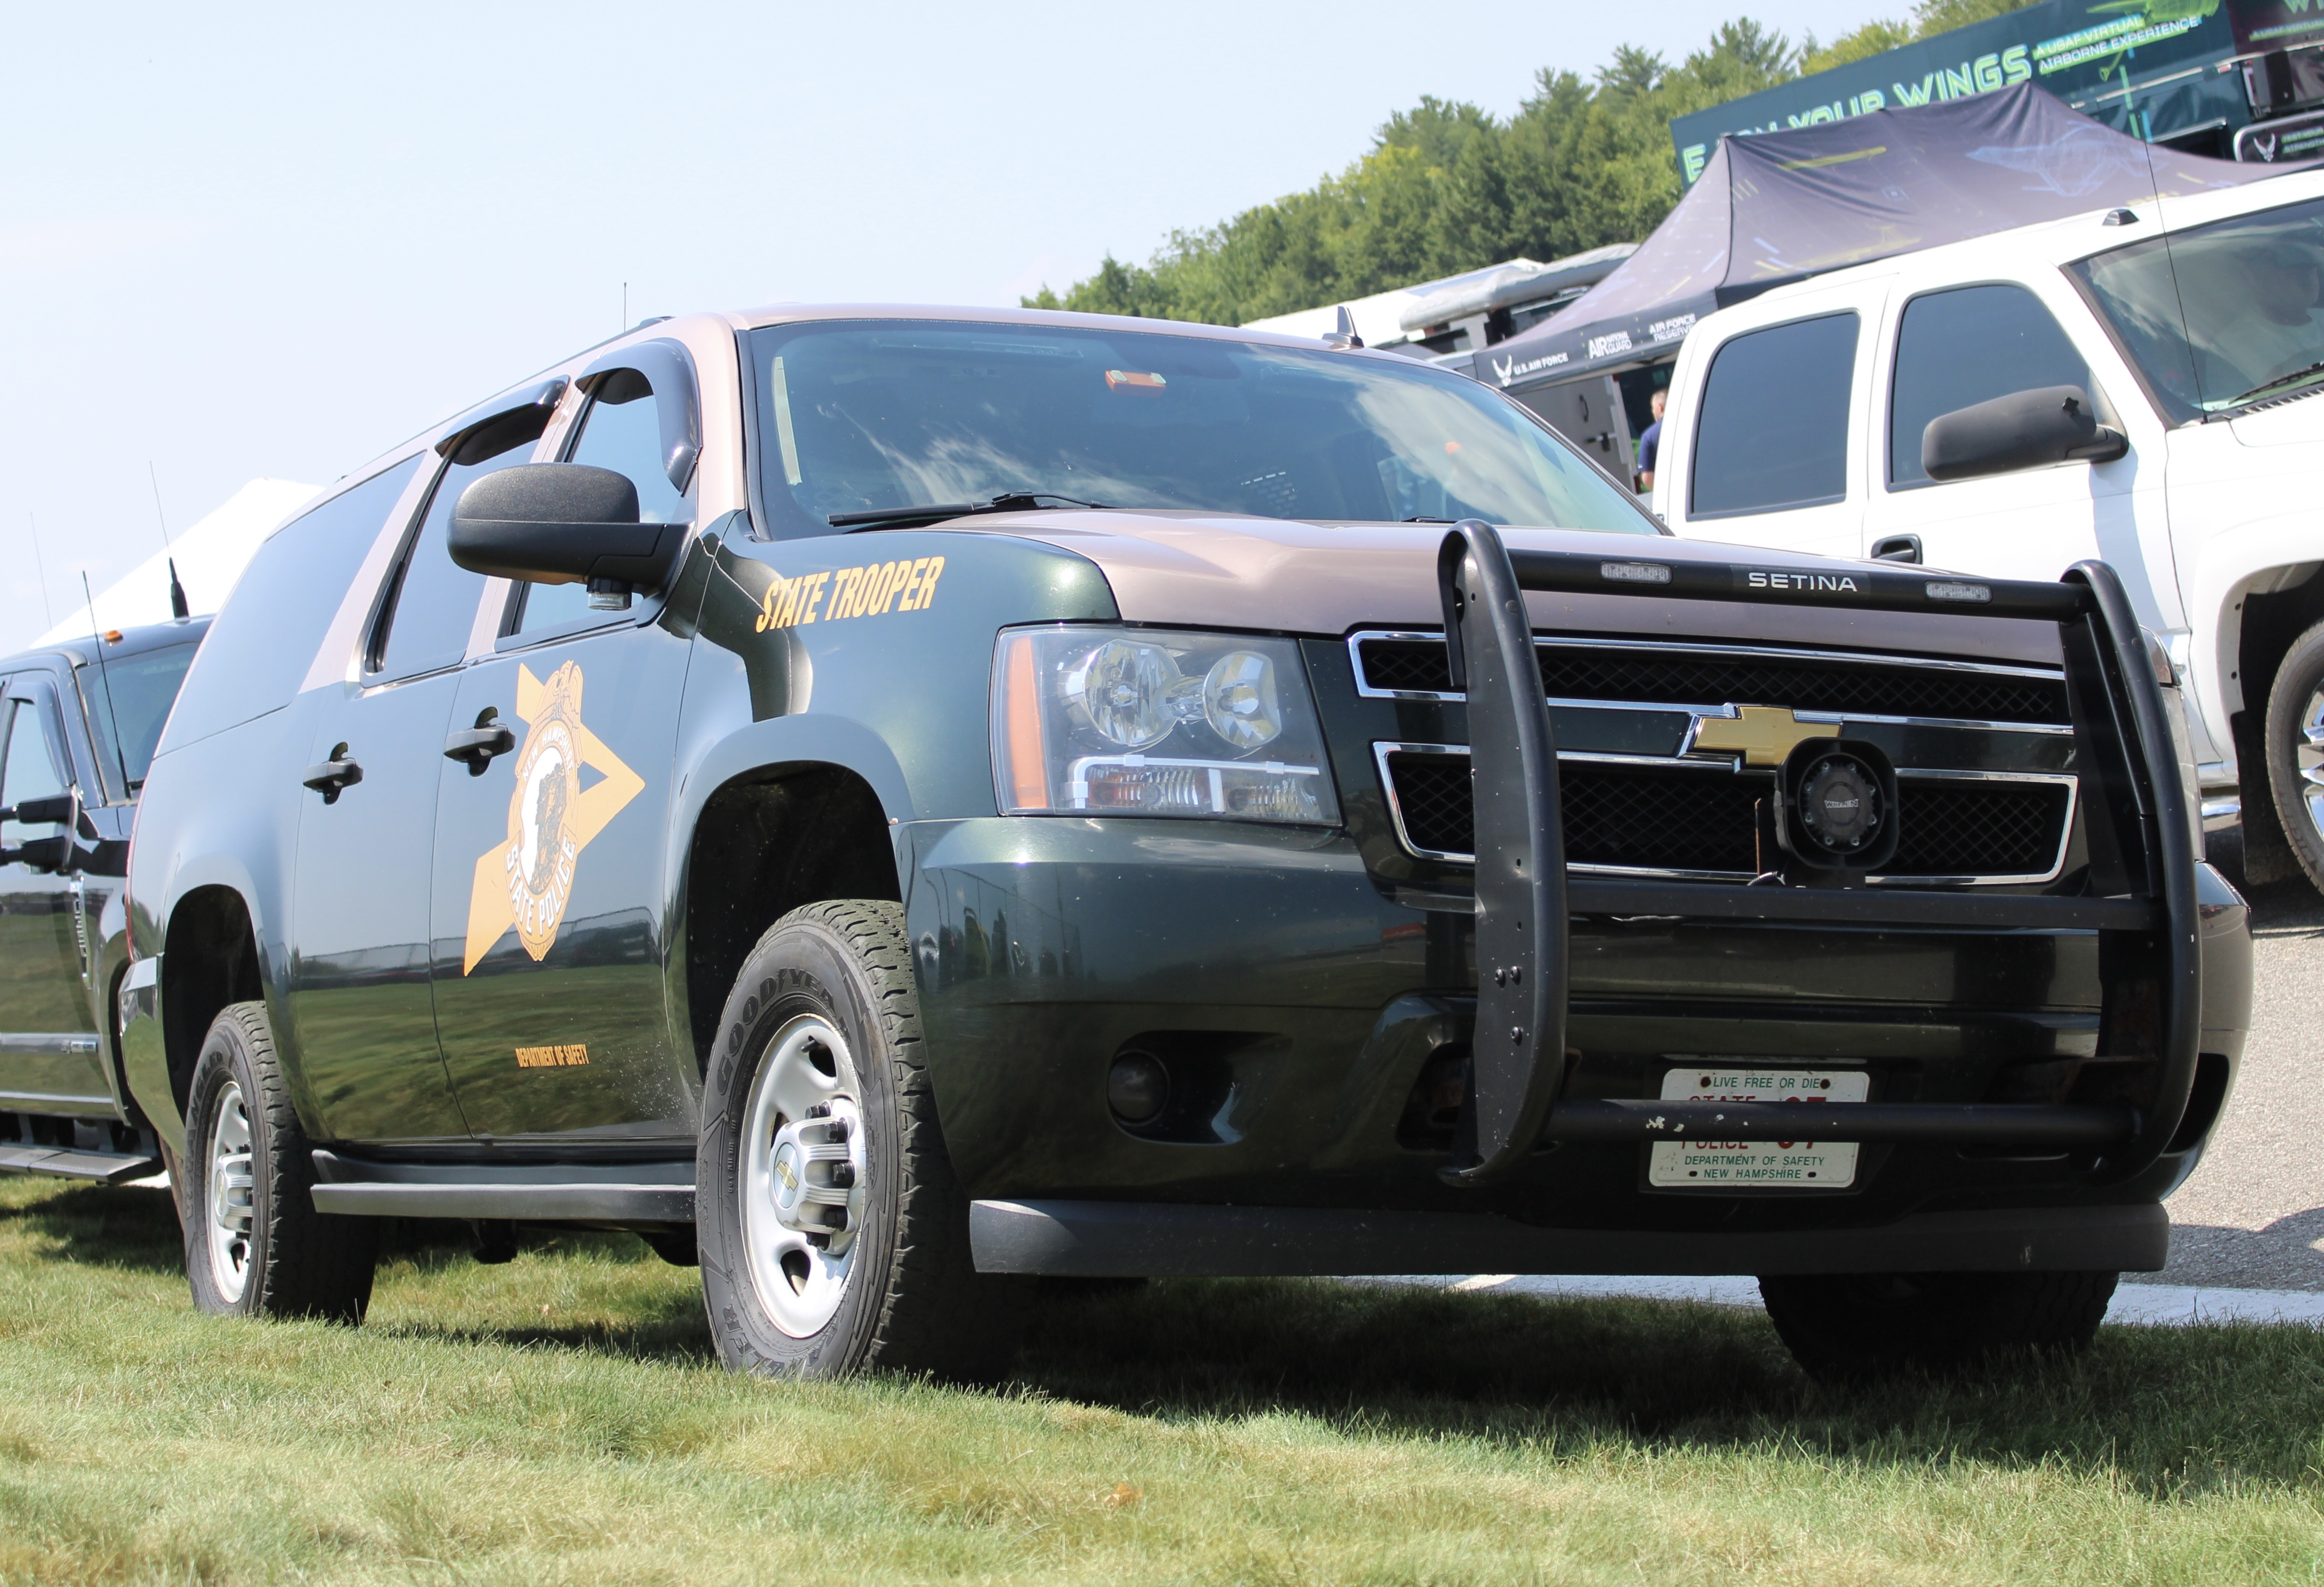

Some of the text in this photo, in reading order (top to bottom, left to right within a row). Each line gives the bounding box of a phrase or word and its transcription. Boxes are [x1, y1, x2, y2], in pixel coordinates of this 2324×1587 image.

[2036, 16, 2144, 57] A USAF VIRTUAL
[2040, 14, 2199, 71] AIRBORNE EXPERIENCE
[1893, 43, 2032, 107] WINGS
[1649, 312, 1696, 335] AIR FORCE
[1589, 336, 1610, 359] AIR
[1606, 330, 1630, 343] NATIONAL
[1608, 339, 1632, 354] GUARD
[1513, 352, 1569, 376] U.S. AIR FORCE
[1748, 572, 1858, 592] SETINA
[754, 555, 946, 633] STATE TROOPER
[523, 726, 573, 782] NEW HAMPSHIRE
[1824, 798, 1859, 808] WHELEN
[507, 834, 576, 936] STATE POLICE
[717, 967, 852, 1095] GOODYEAR
[514, 1044, 589, 1067] DEPARTMENT OF SAFETY
[1713, 1077, 1820, 1089] LIVE FREE OR DIE
[1684, 1155, 1825, 1166] DEPARTMENT OF SAFETY
[1703, 1169, 1802, 1179] NEW HAMPSHIRE
